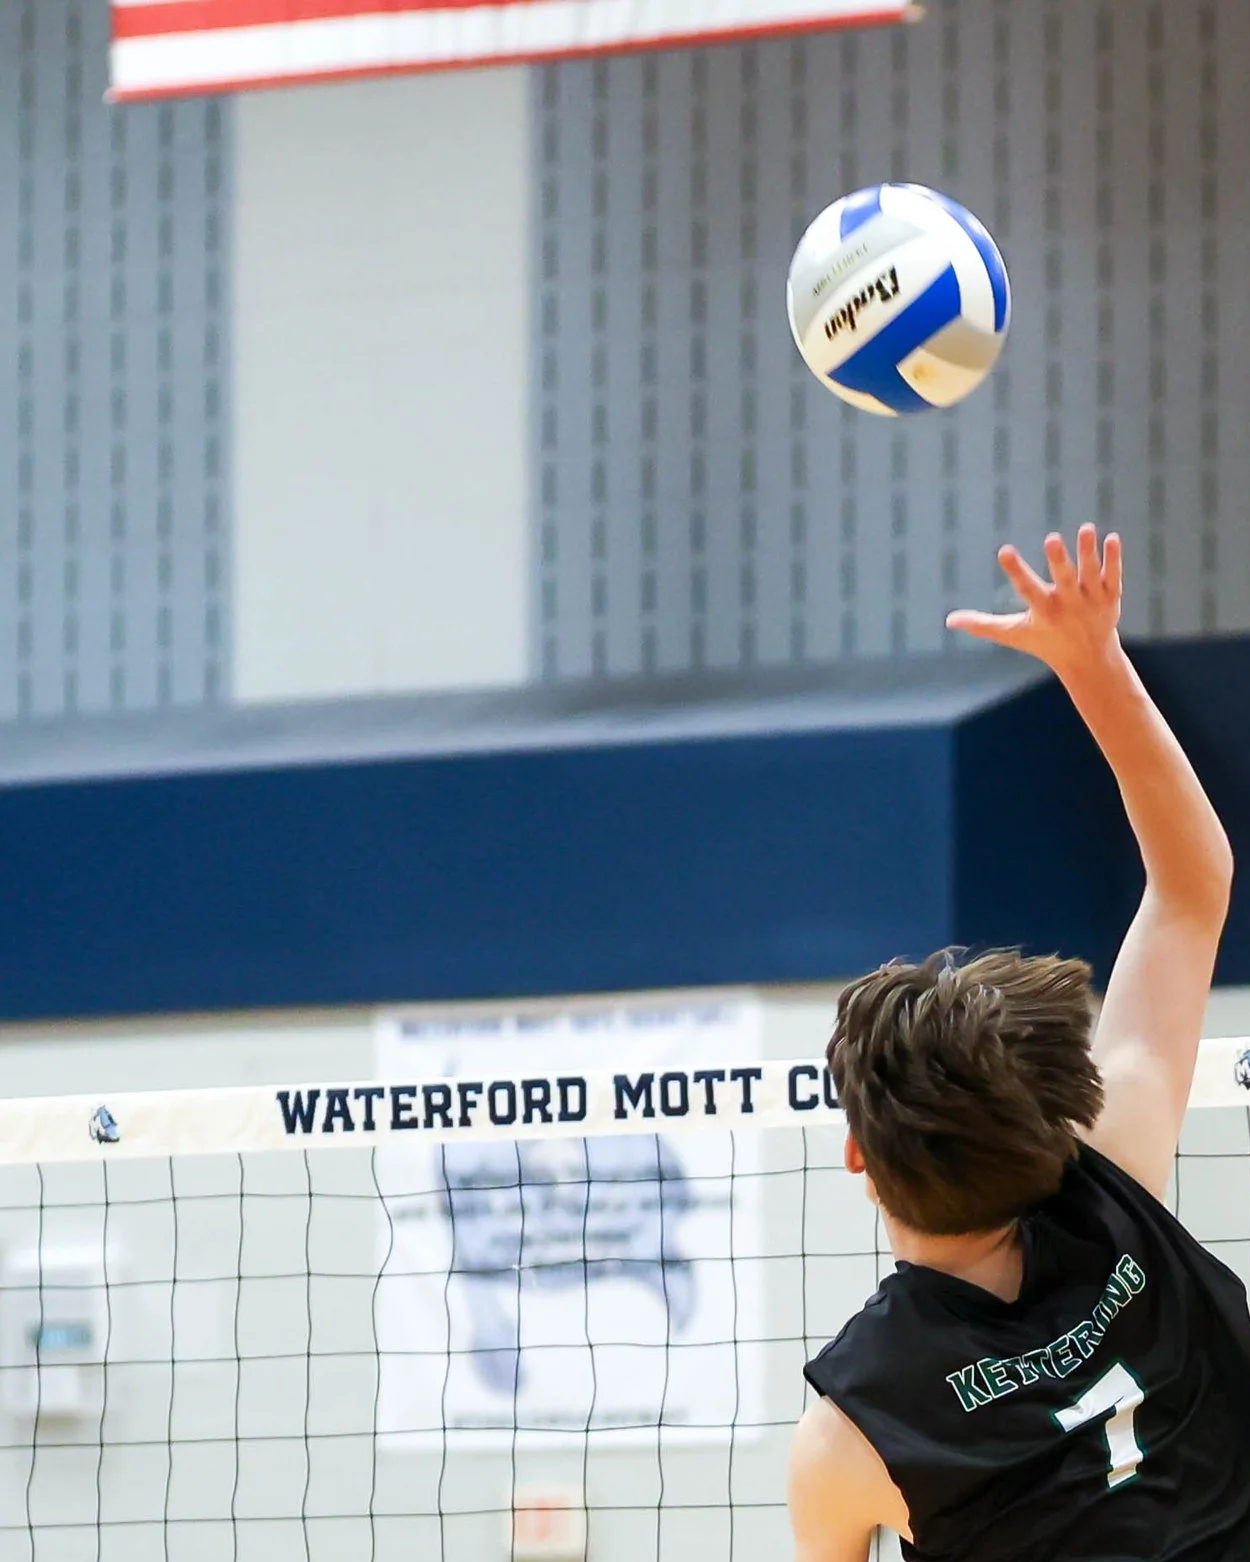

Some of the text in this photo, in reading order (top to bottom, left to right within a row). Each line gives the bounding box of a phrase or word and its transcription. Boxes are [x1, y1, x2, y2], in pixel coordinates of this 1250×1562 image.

[276, 1076, 587, 1134] WATERFORD
[613, 1068, 762, 1119] MOTT
[946, 1253, 1146, 1412] KETTERING
[1052, 1360, 1147, 1490] 7
